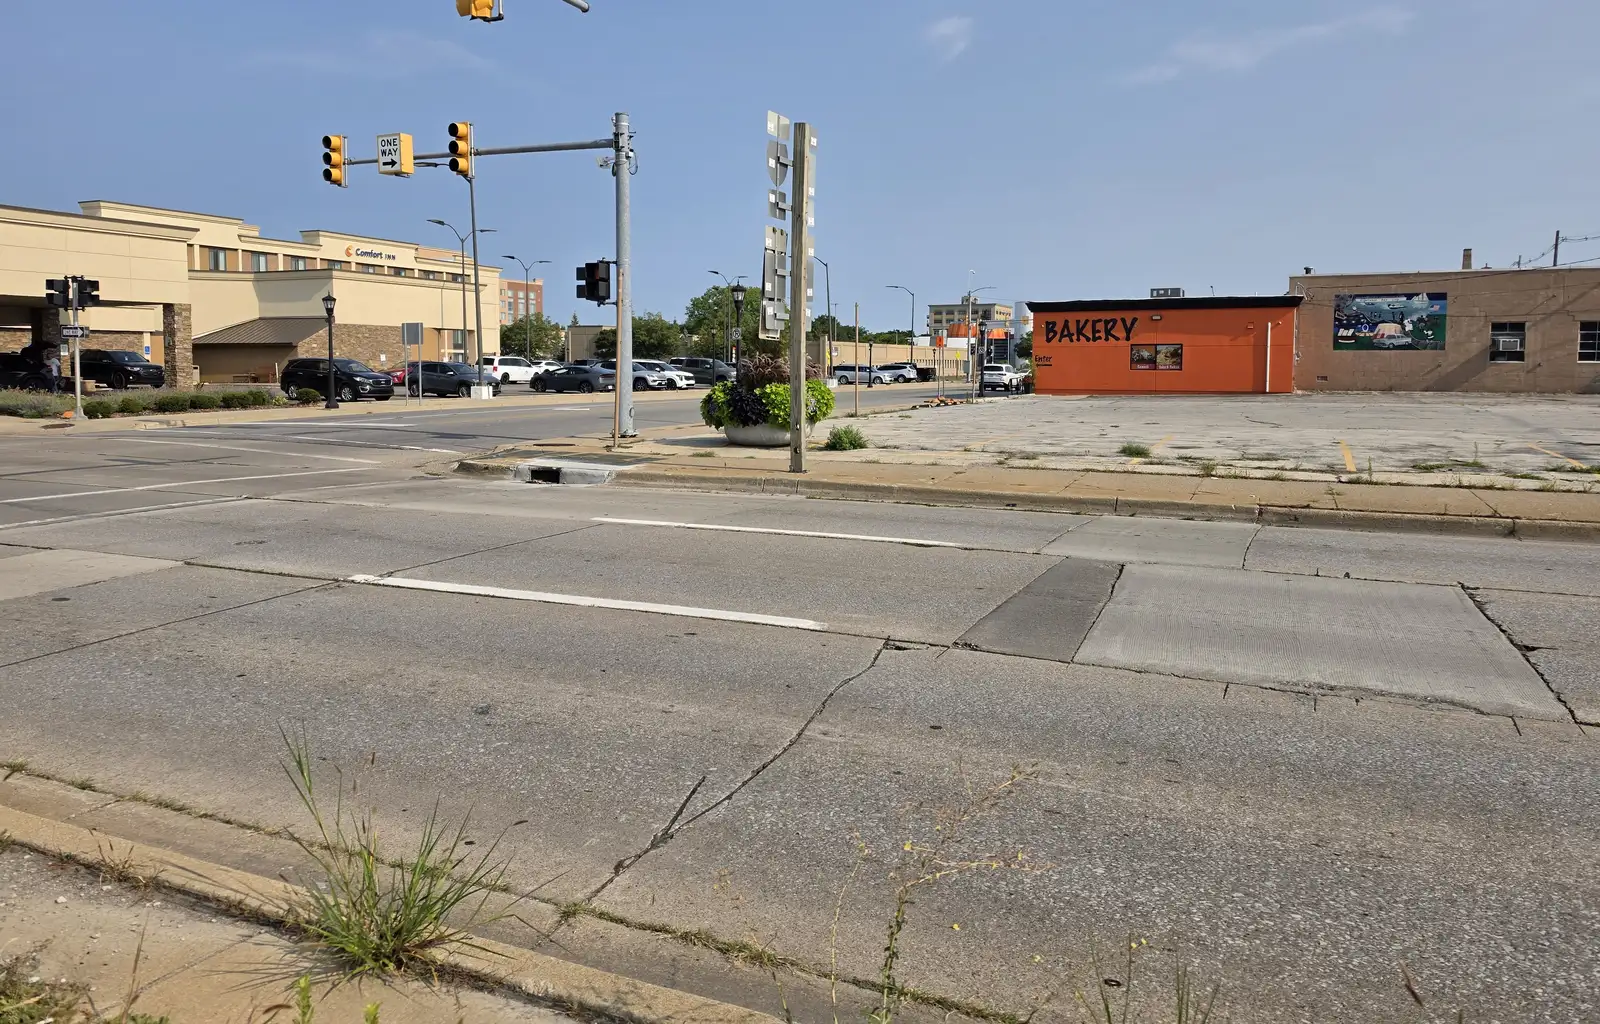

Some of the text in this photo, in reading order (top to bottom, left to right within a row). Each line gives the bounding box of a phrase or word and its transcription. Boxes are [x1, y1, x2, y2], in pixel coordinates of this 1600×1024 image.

[380, 138, 398, 147] ONE
[380, 148, 398, 157] WAY
[355, 248, 383, 259] Comfort
[1045, 317, 1139, 343] BAKERY
